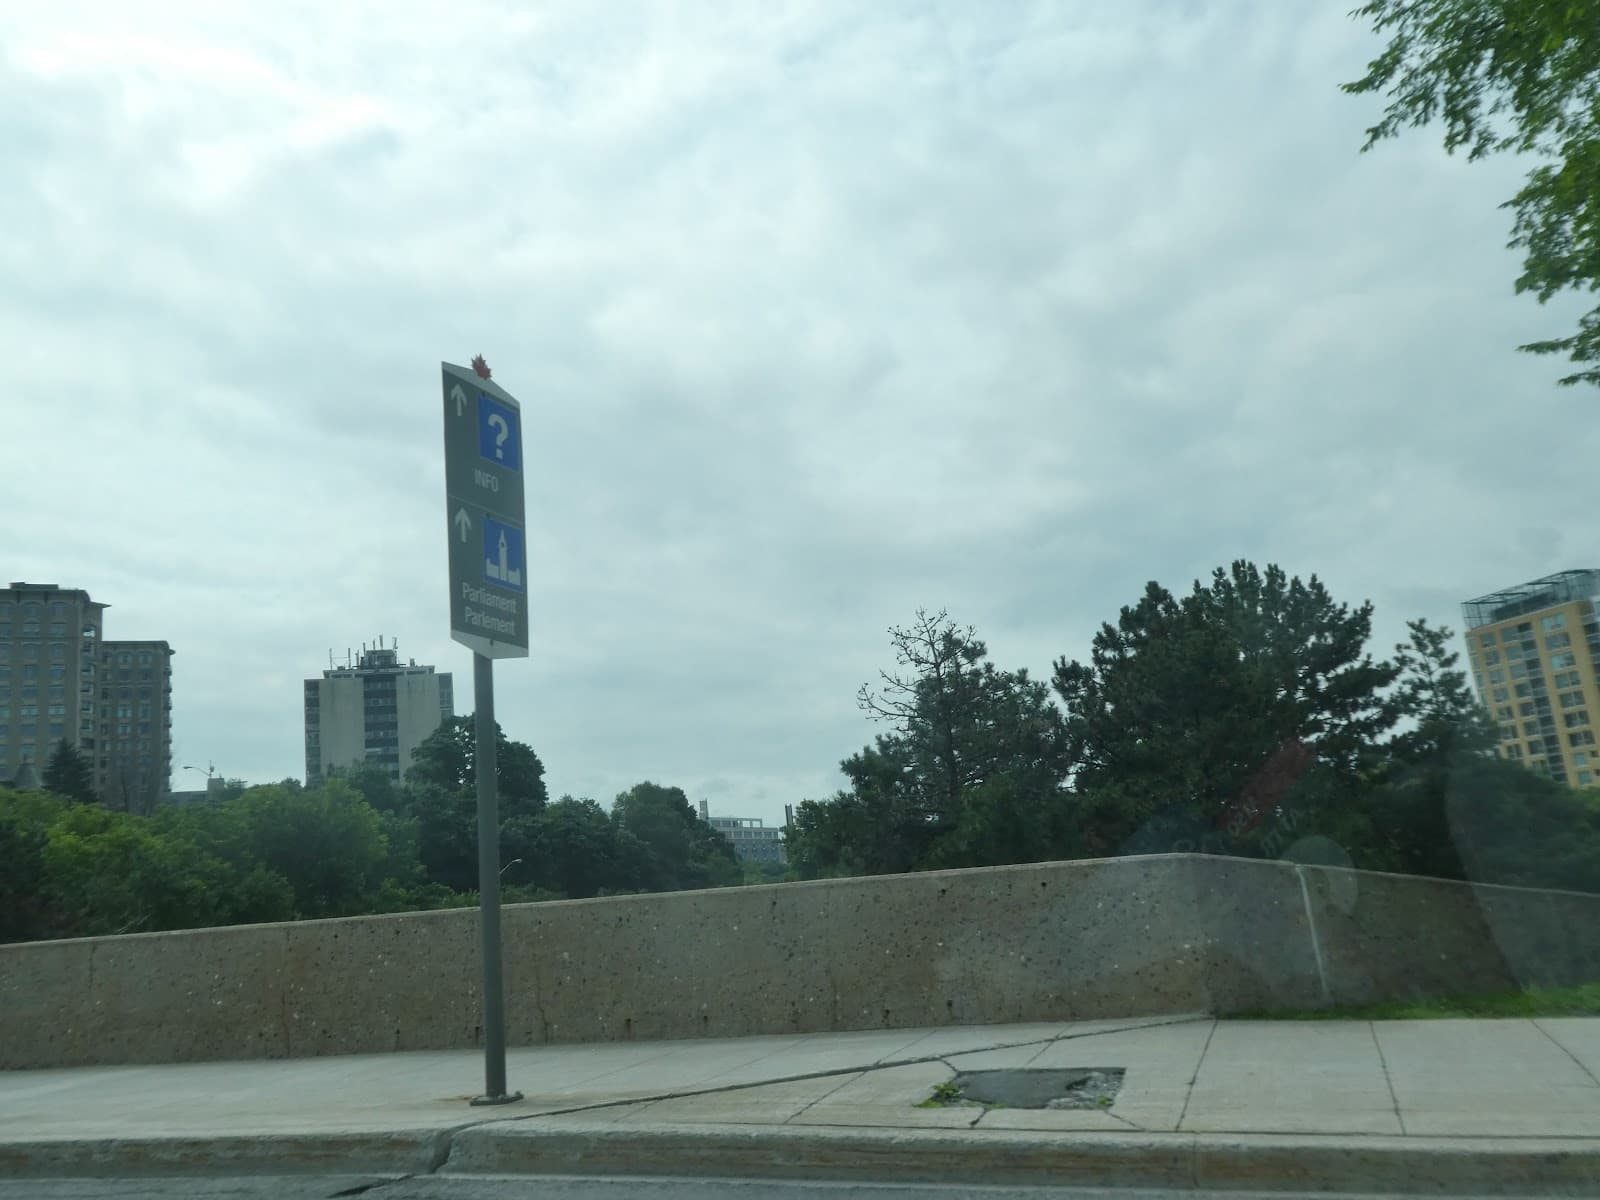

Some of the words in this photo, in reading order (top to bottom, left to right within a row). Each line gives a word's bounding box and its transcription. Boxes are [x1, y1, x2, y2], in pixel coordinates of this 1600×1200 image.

[474, 468, 499, 492] INFO
[462, 582, 517, 614] Parliament
[465, 606, 516, 636] Parlement
